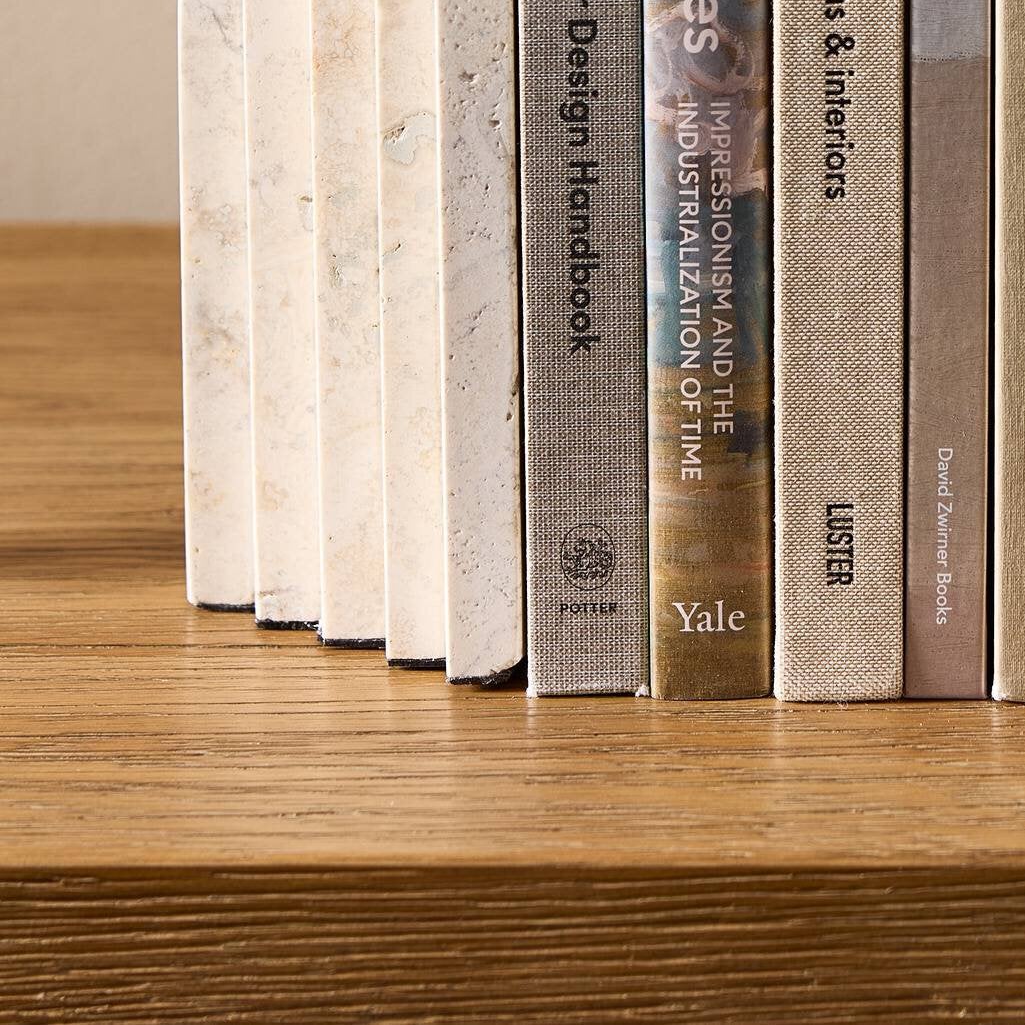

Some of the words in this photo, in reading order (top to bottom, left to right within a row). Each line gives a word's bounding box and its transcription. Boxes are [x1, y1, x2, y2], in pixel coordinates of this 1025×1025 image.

[824, 33, 856, 57] &
[559, 19, 598, 147] Design
[824, 70, 855, 201] interiors
[677, 101, 701, 369] INDUSTRIALIZATION
[710, 101, 733, 310] IMPRESSIONISM
[568, 160, 600, 355] Handbook
[712, 317, 734, 376] AND
[680, 377, 702, 414] OF
[712, 383, 734, 434] THE
[681, 422, 702, 481] TIME
[937, 448, 953, 496] David
[826, 503, 854, 586] LUSTER
[936, 502, 953, 567] Zwirner
[560, 603, 618, 614] POTTER
[672, 600, 746, 632] Yale
[936, 572, 952, 625] Books
